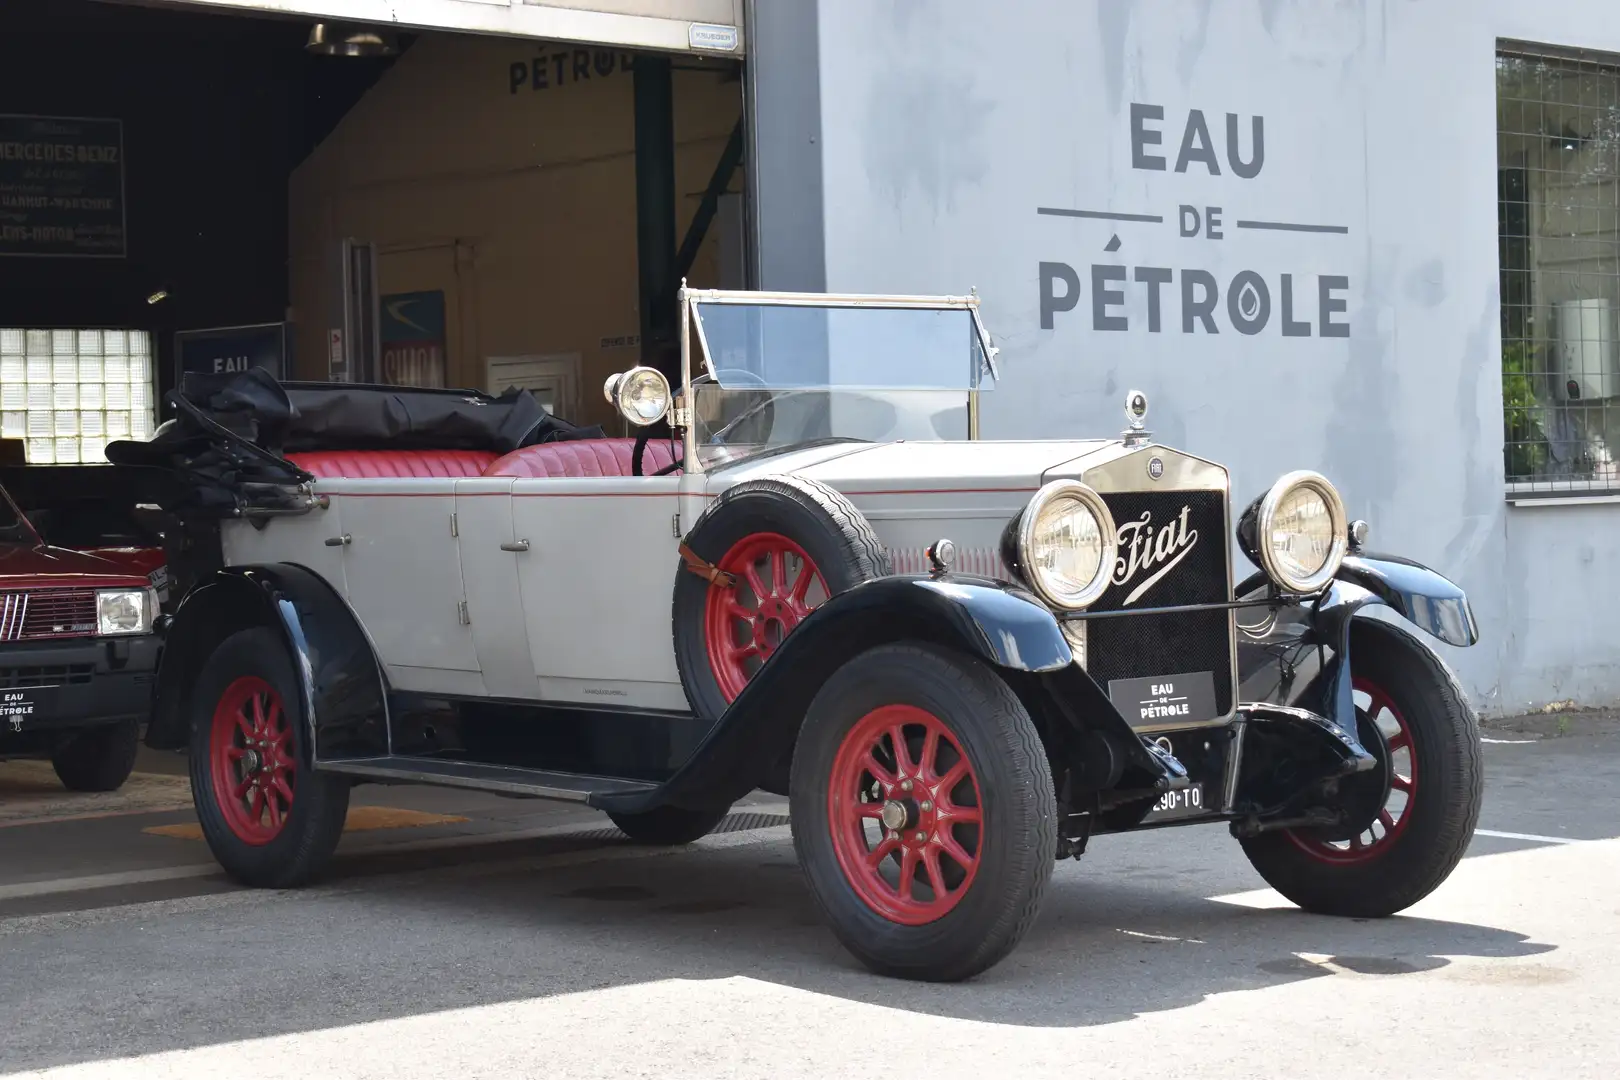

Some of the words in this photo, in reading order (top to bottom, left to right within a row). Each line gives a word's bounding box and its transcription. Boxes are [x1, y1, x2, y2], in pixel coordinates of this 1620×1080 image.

[509, 47, 635, 95] PÉTROL
[1130, 102, 1265, 179] EAU
[1179, 204, 1224, 240] DE
[1038, 233, 1350, 338] PÉTROLE
[213, 356, 248, 374] EAU
[1111, 505, 1198, 606] Fiat
[4, 693, 24, 702] EAU
[1151, 683, 1174, 696] EAU
[0, 706, 34, 716] ÉTROLE
[1140, 704, 1189, 719] PÉTROLE
